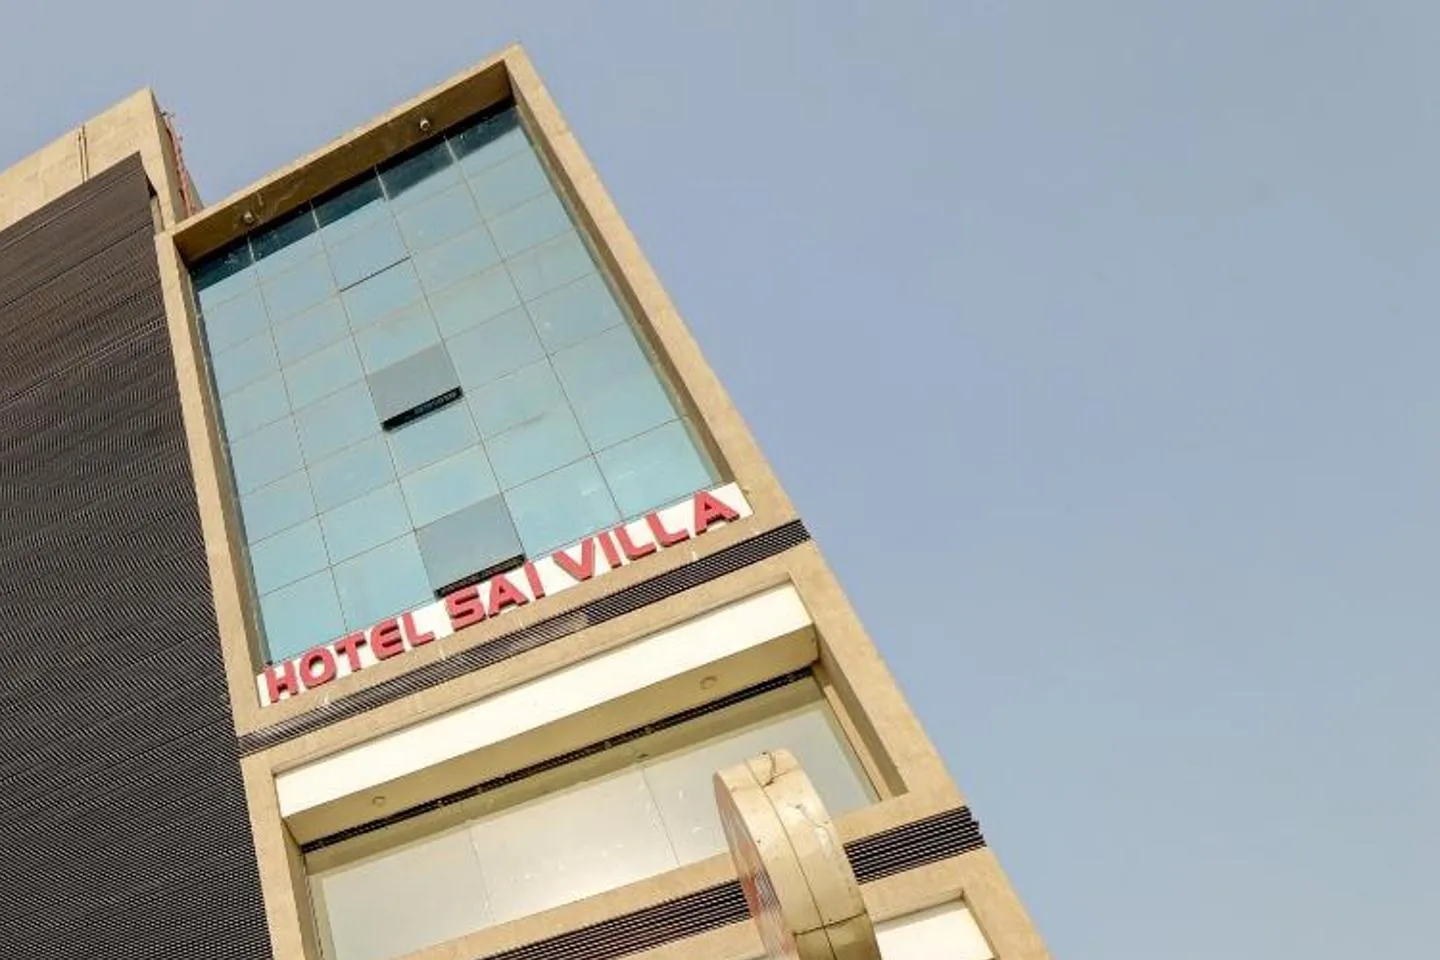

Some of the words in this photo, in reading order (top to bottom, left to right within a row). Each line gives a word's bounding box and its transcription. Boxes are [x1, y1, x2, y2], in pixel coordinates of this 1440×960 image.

[264, 611, 435, 703] HOTEL
[443, 560, 547, 632] SAI
[551, 489, 741, 581] VILLA
